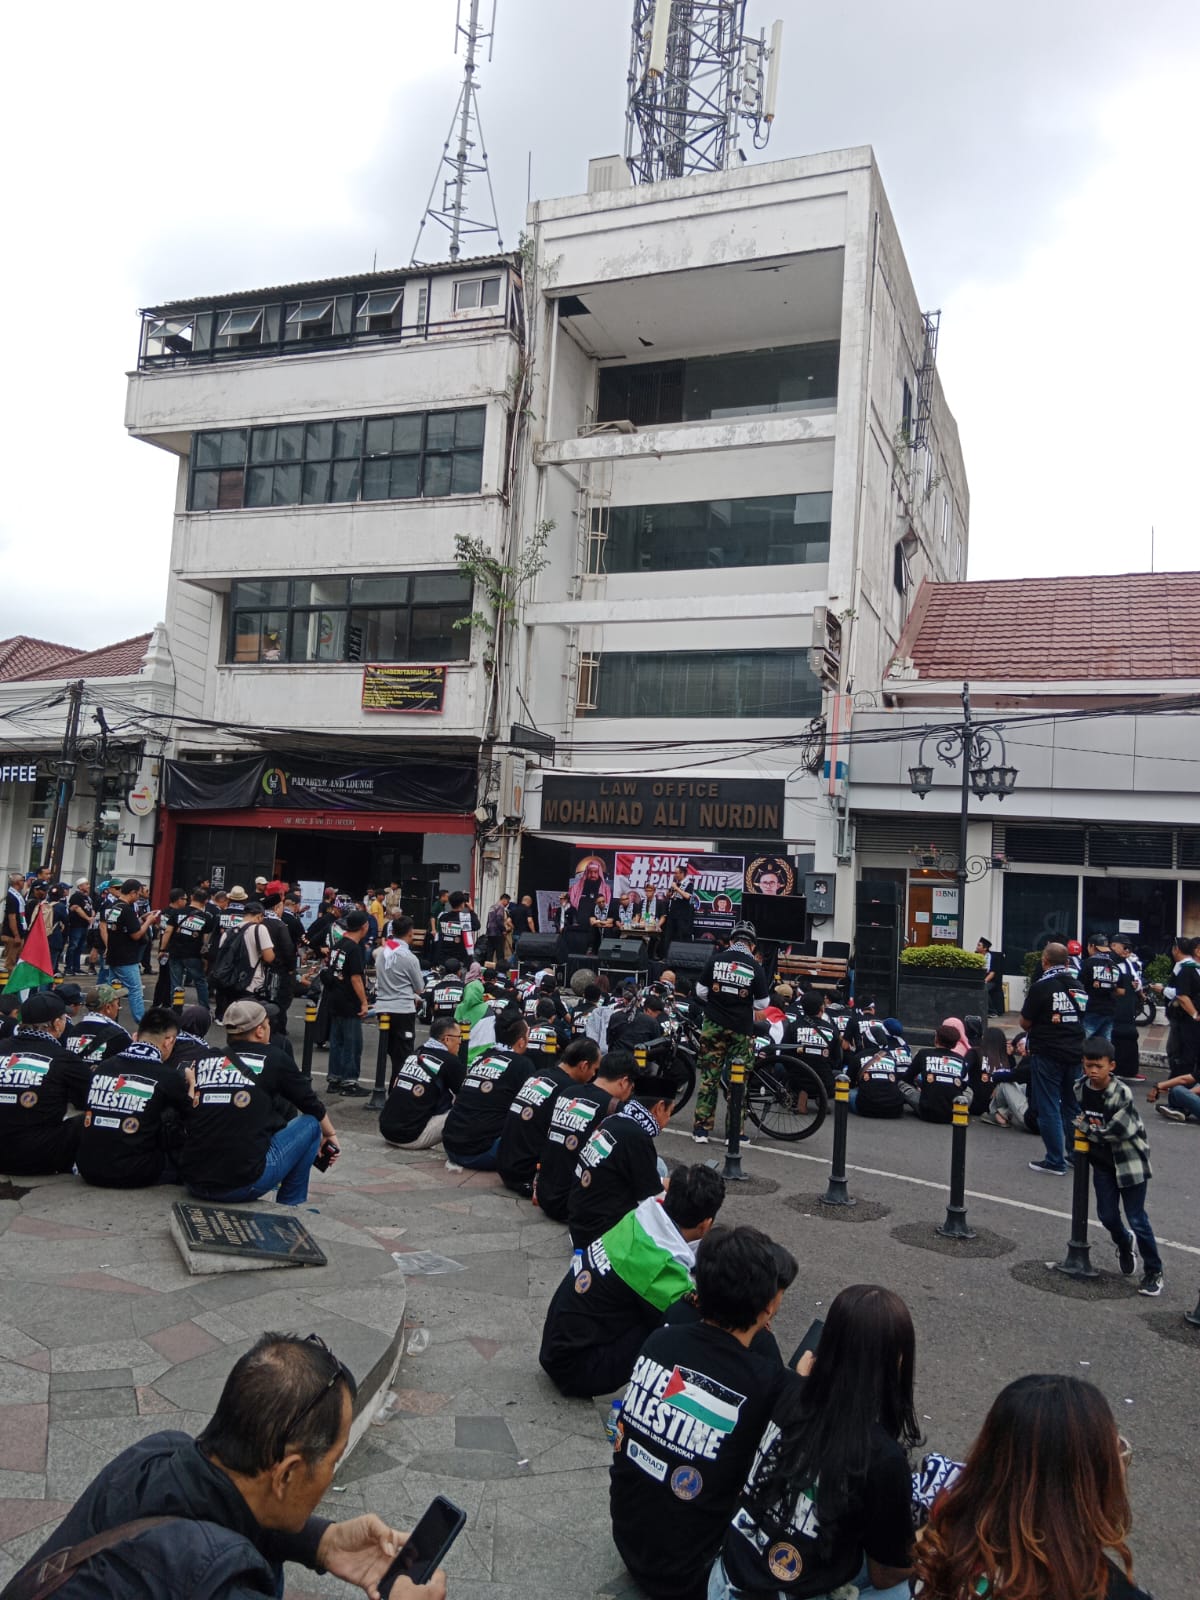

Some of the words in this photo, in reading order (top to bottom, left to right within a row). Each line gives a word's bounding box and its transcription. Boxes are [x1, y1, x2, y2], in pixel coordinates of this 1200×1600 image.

[0, 765, 37, 782] FFEE
[600, 782, 638, 796] LAW
[652, 783, 720, 798] OFFICE
[543, 800, 644, 826] MOHAMAD
[653, 802, 687, 827] ALI
[699, 804, 780, 830] NURDIN
[714, 961, 733, 972] SAVE
[91, 1074, 120, 1092] SAVE
[87, 1089, 147, 1113] PALESTINE
[630, 1355, 674, 1400] SAVE
[666, 1442, 695, 1460] ADVOKAT
[638, 1448, 665, 1473] PERADI
